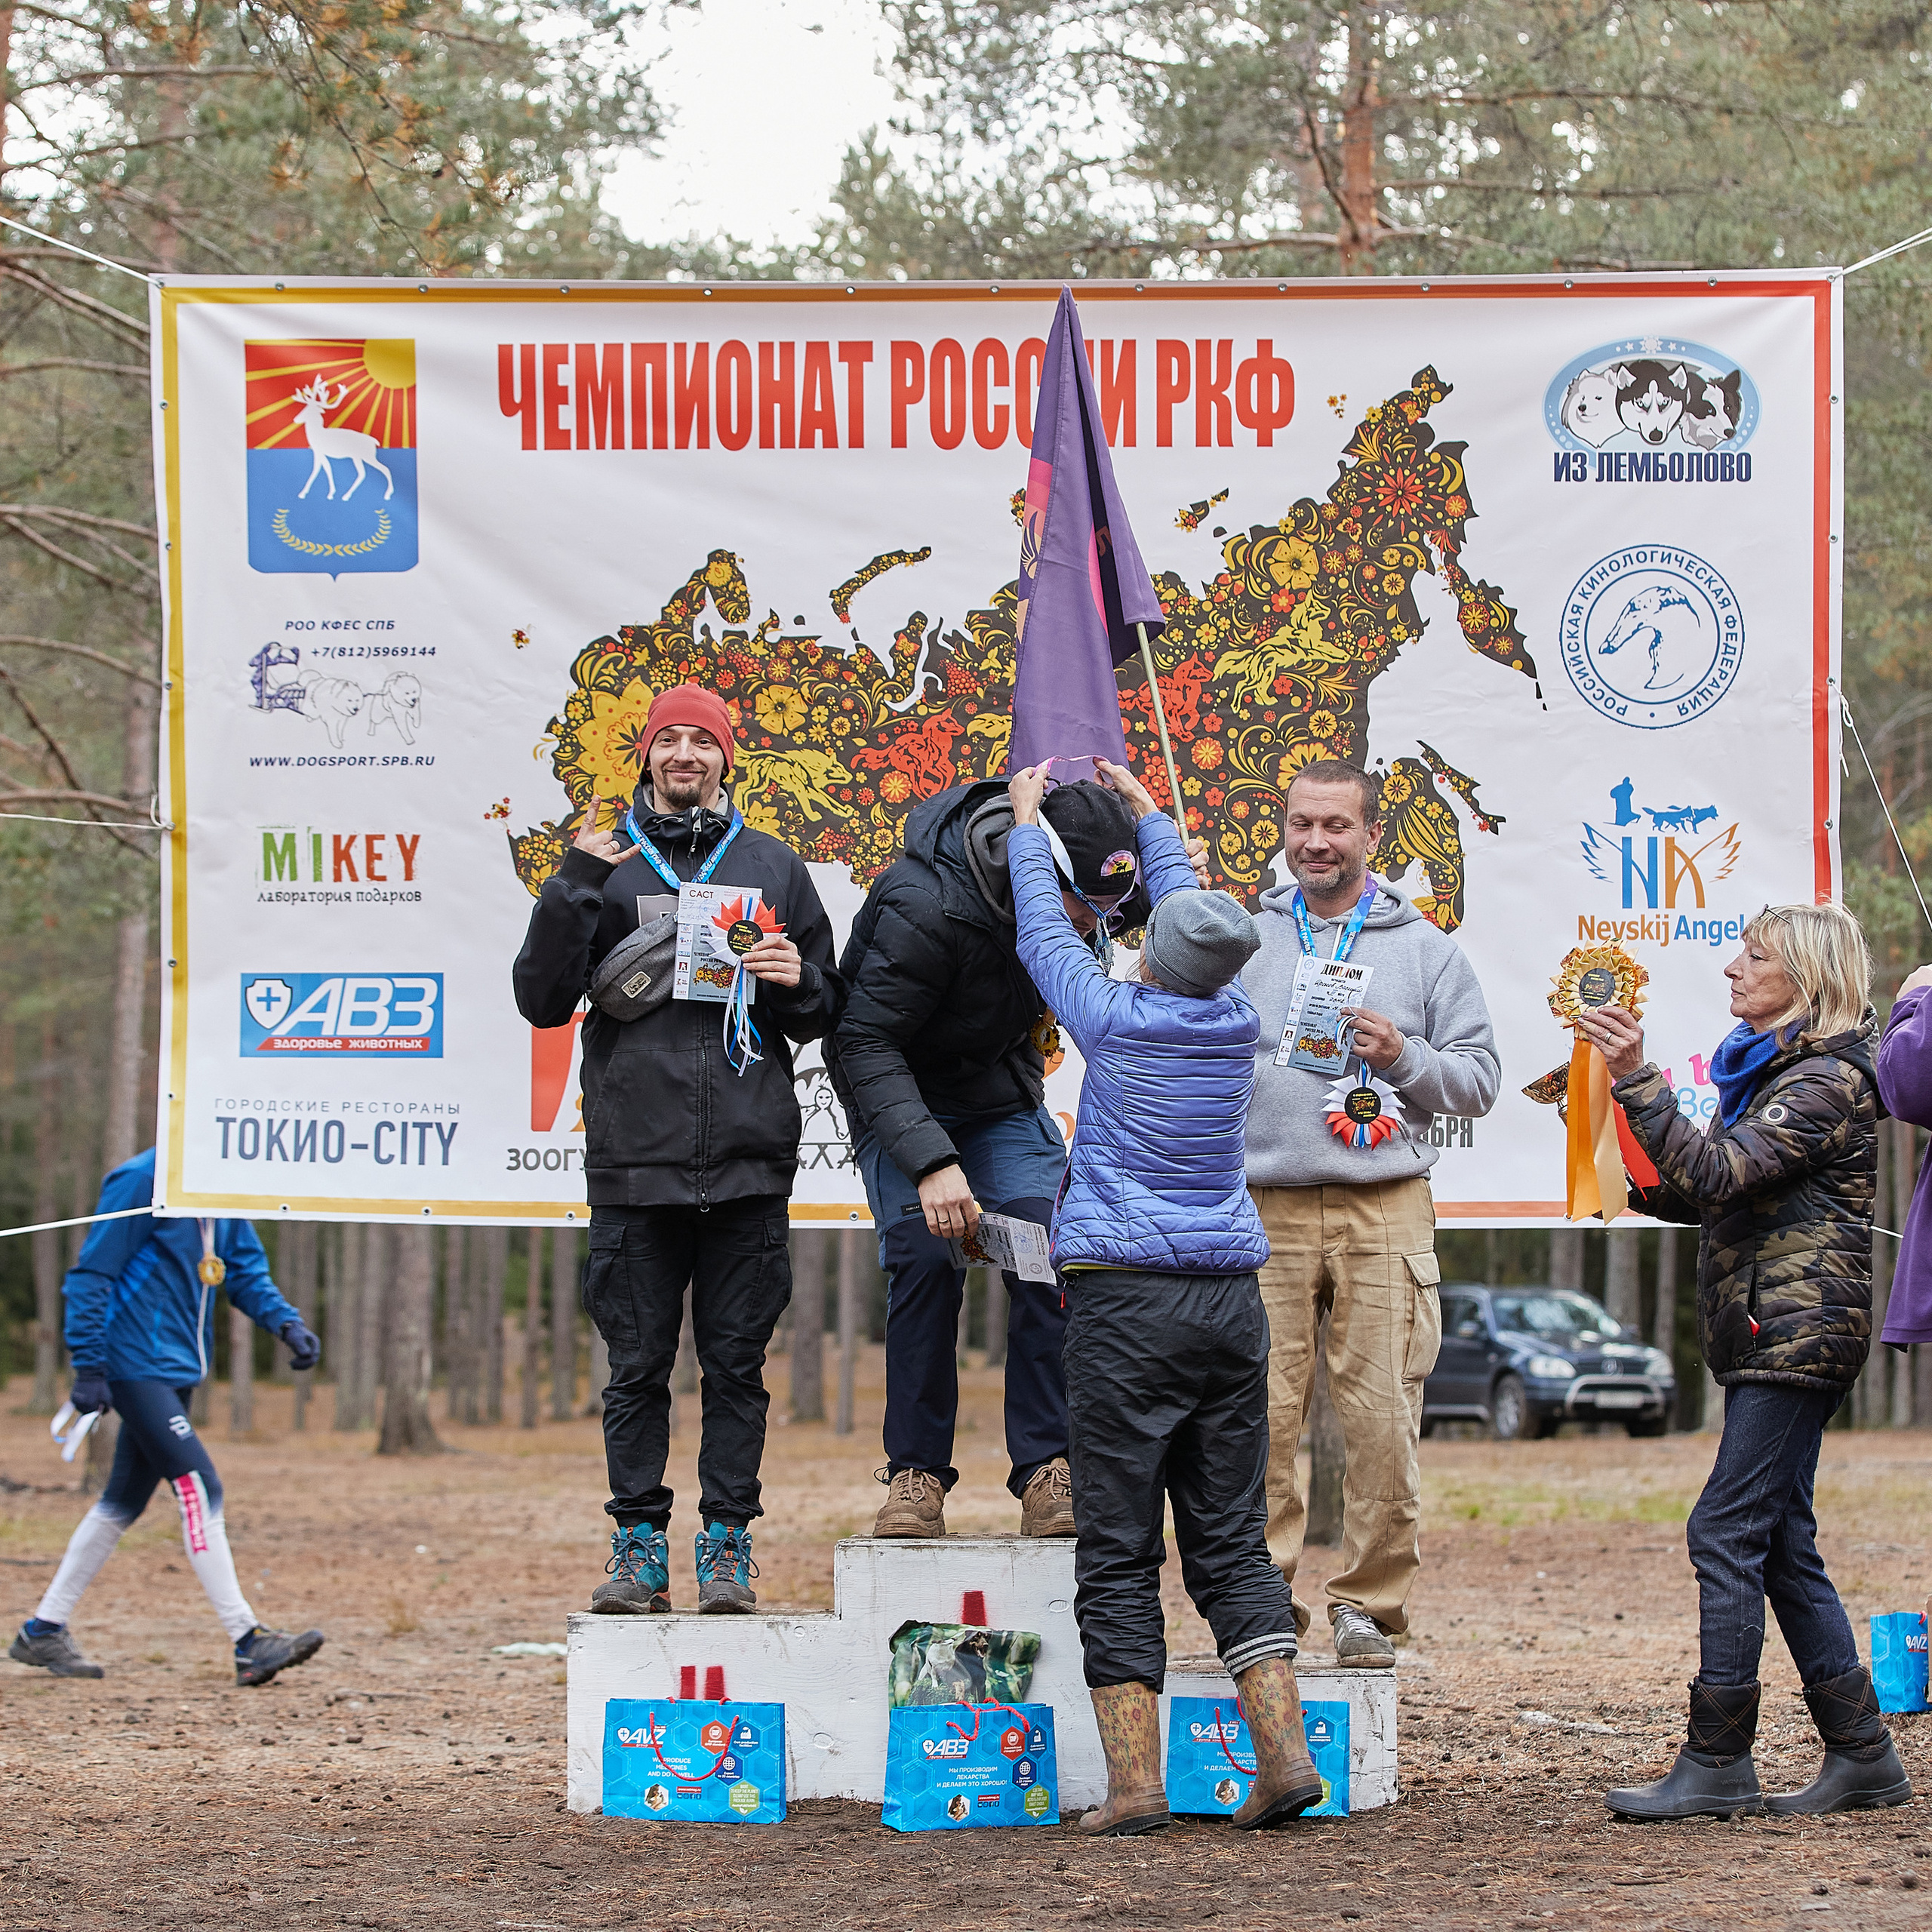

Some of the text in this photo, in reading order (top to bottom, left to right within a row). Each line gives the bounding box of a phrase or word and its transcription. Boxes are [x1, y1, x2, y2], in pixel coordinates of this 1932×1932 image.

[497, 337, 1295, 451] ЧЕМПИОНАТ РОССИ РКФ
[1553, 452, 1752, 482] ИЗ ЛЕМБОЛОВО
[285, 620, 395, 630] РОО КФЕС СПБ
[1567, 550, 1738, 716] РОССИЙСКАЯ КИНОЛОГИЧЕСКАЯ ФЕДЕРАЦИЯ
[311, 647, 437, 658] +7(812)5969144
[250, 755, 435, 767] WWW.DOGSPORT.SPB.RU
[263, 832, 421, 882] MIKEY
[356, 888, 423, 906] подарков
[1577, 914, 1744, 947] Nevskij Angel
[1321, 964, 1363, 980] ДИПЛОМ
[270, 977, 438, 1035] АВЗ
[348, 1039, 423, 1049] животных
[215, 1098, 460, 1114] ГОРОДСКИЕ РЕСТОРАНЫ
[1423, 1115, 1473, 1147] БРЯ
[1909, 1635, 1927, 1650] AVZ
[624, 1728, 666, 1745] AVZ
[1196, 1724, 1239, 1740] АВЗ
[929, 1739, 969, 1755] АВЗ
